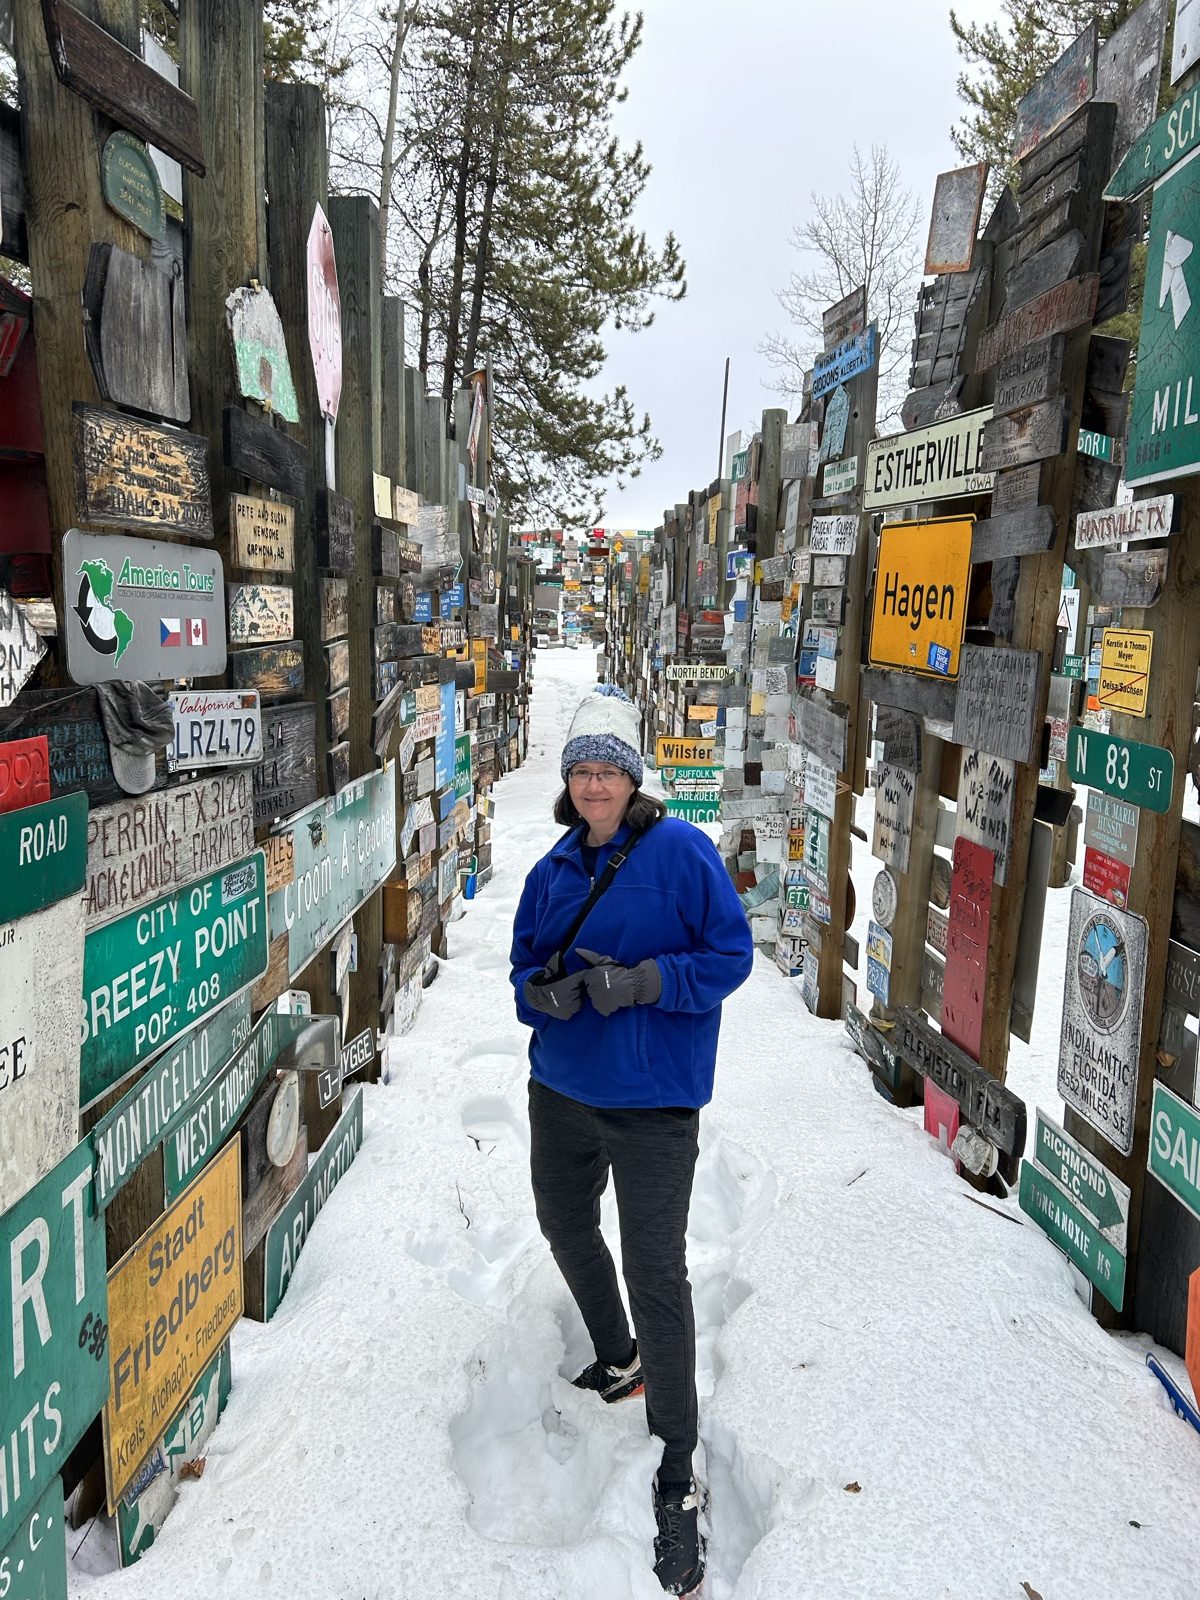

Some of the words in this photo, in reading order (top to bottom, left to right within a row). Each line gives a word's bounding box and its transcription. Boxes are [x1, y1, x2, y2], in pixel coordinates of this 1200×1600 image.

[1144, 144, 1151, 169] 2
[874, 427, 985, 493] ESTHERVILLE
[964, 475, 991, 492] IOWA
[237, 504, 254, 518] PETE
[257, 509, 269, 522] AND
[270, 511, 287, 525] SUSAN
[1146, 505, 1166, 532] TX
[117, 556, 180, 590] America
[183, 563, 215, 592] Tours
[882, 572, 955, 631] Hagen
[1106, 638, 1123, 649] Kerstin
[1129, 641, 1148, 651] Thomas
[1118, 650, 1134, 661] Meyer
[672, 667, 697, 679] NORTH
[700, 667, 730, 679] BENTON
[179, 696, 236, 716] California
[662, 743, 713, 760] Wilster
[1076, 734, 1088, 775] N
[1105, 743, 1130, 790] 83
[1148, 767, 1163, 792] ST
[19, 814, 68, 866] ROAD
[1113, 803, 1135, 828] MARIA
[192, 814, 251, 874] FARMER
[136, 900, 178, 945] CITY
[190, 882, 213, 916] OF
[80, 940, 182, 1047] BREEZY
[194, 896, 260, 969] POINT
[186, 972, 220, 1014] 408
[1063, 1020, 1130, 1086] INDIALANTIC
[1072, 1053, 1117, 1105] FLORIDA
[98, 1029, 209, 1200] MONTICELLO
[175, 1094, 214, 1182] WEST
[218, 1033, 260, 1132] ENDERBY
[1081, 1083, 1109, 1121] MILES
[1042, 1126, 1107, 1198] RICHMOND
[1154, 1110, 1200, 1192] SAI
[1061, 1163, 1084, 1200] B.C.
[148, 1195, 205, 1288] Stadt
[113, 1225, 237, 1413] Friedberg
[117, 1418, 146, 1475] Kreis
[150, 1354, 188, 1424] Aichach
[195, 1289, 237, 1358] Friedberg
